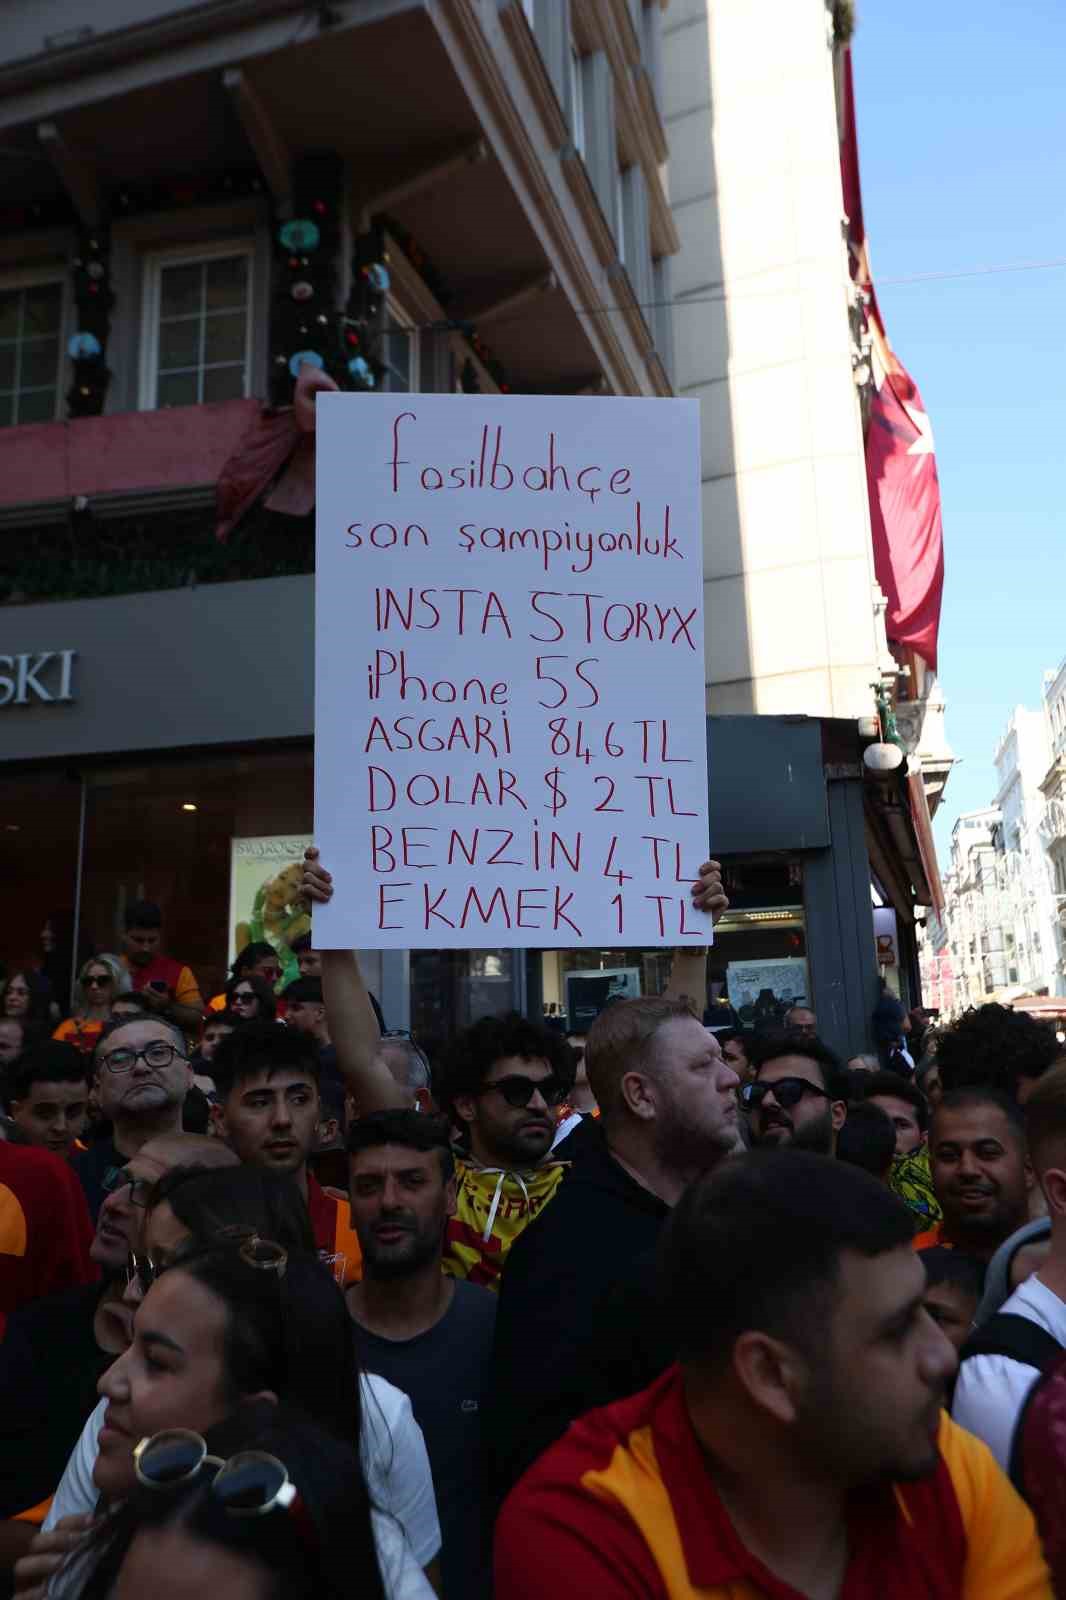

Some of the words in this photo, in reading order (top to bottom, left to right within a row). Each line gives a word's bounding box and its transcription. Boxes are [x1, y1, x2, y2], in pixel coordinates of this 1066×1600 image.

[344, 523, 430, 550] son
[457, 500, 684, 574] şampiyonluk
[375, 586, 513, 640] INSTA
[367, 648, 509, 705] iPhone
[535, 655, 600, 710] 5S
[367, 765, 528, 813] DOLAR
[593, 775, 625, 813] 2
[633, 775, 700, 818] TL
[639, 835, 700, 883] TL
[378, 882, 583, 938] EKMEK
[610, 892, 623, 935] 1
[643, 895, 704, 938] TL
